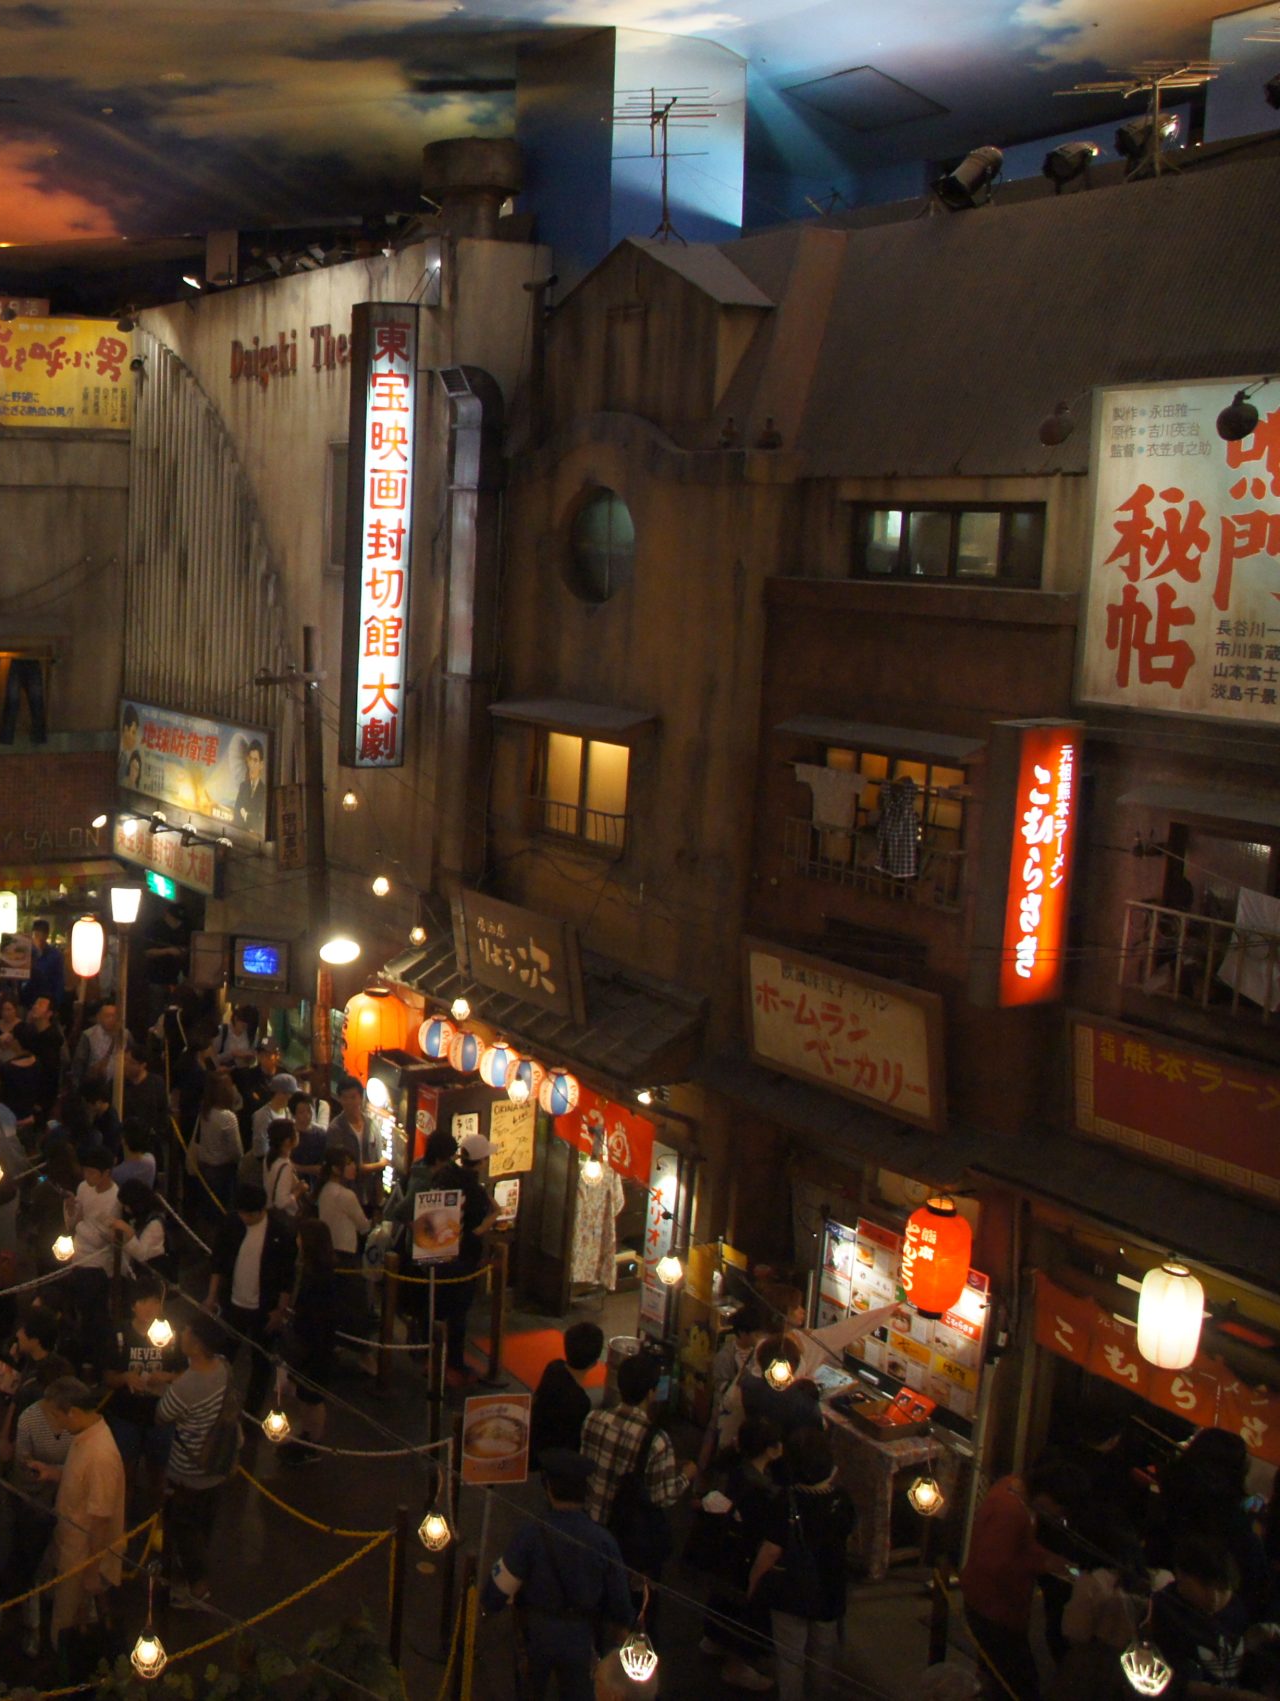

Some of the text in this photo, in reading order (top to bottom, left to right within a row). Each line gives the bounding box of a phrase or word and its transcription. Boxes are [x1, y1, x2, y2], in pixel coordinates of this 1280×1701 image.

[229, 328, 297, 390] Daigeki
[1110, 441, 1213, 458] 監督 衣笠貞之助
[1111, 421, 1200, 439] 原作 吉川英治
[1103, 483, 1211, 690] 秘帖
[1210, 684, 1277, 706] 淡島千景
[141, 724, 220, 766] 地球防衛軍
[1049, 744, 1074, 889] 元祖熊本ラーメン
[23, 827, 100, 850] SALON
[1015, 764, 1054, 978] こむらさき
[755, 980, 871, 1042] ホームラン
[1099, 1031, 1117, 1064] 元祖
[805, 1037, 927, 1103] ベーカリー
[418, 1192, 442, 1203] YUJI
